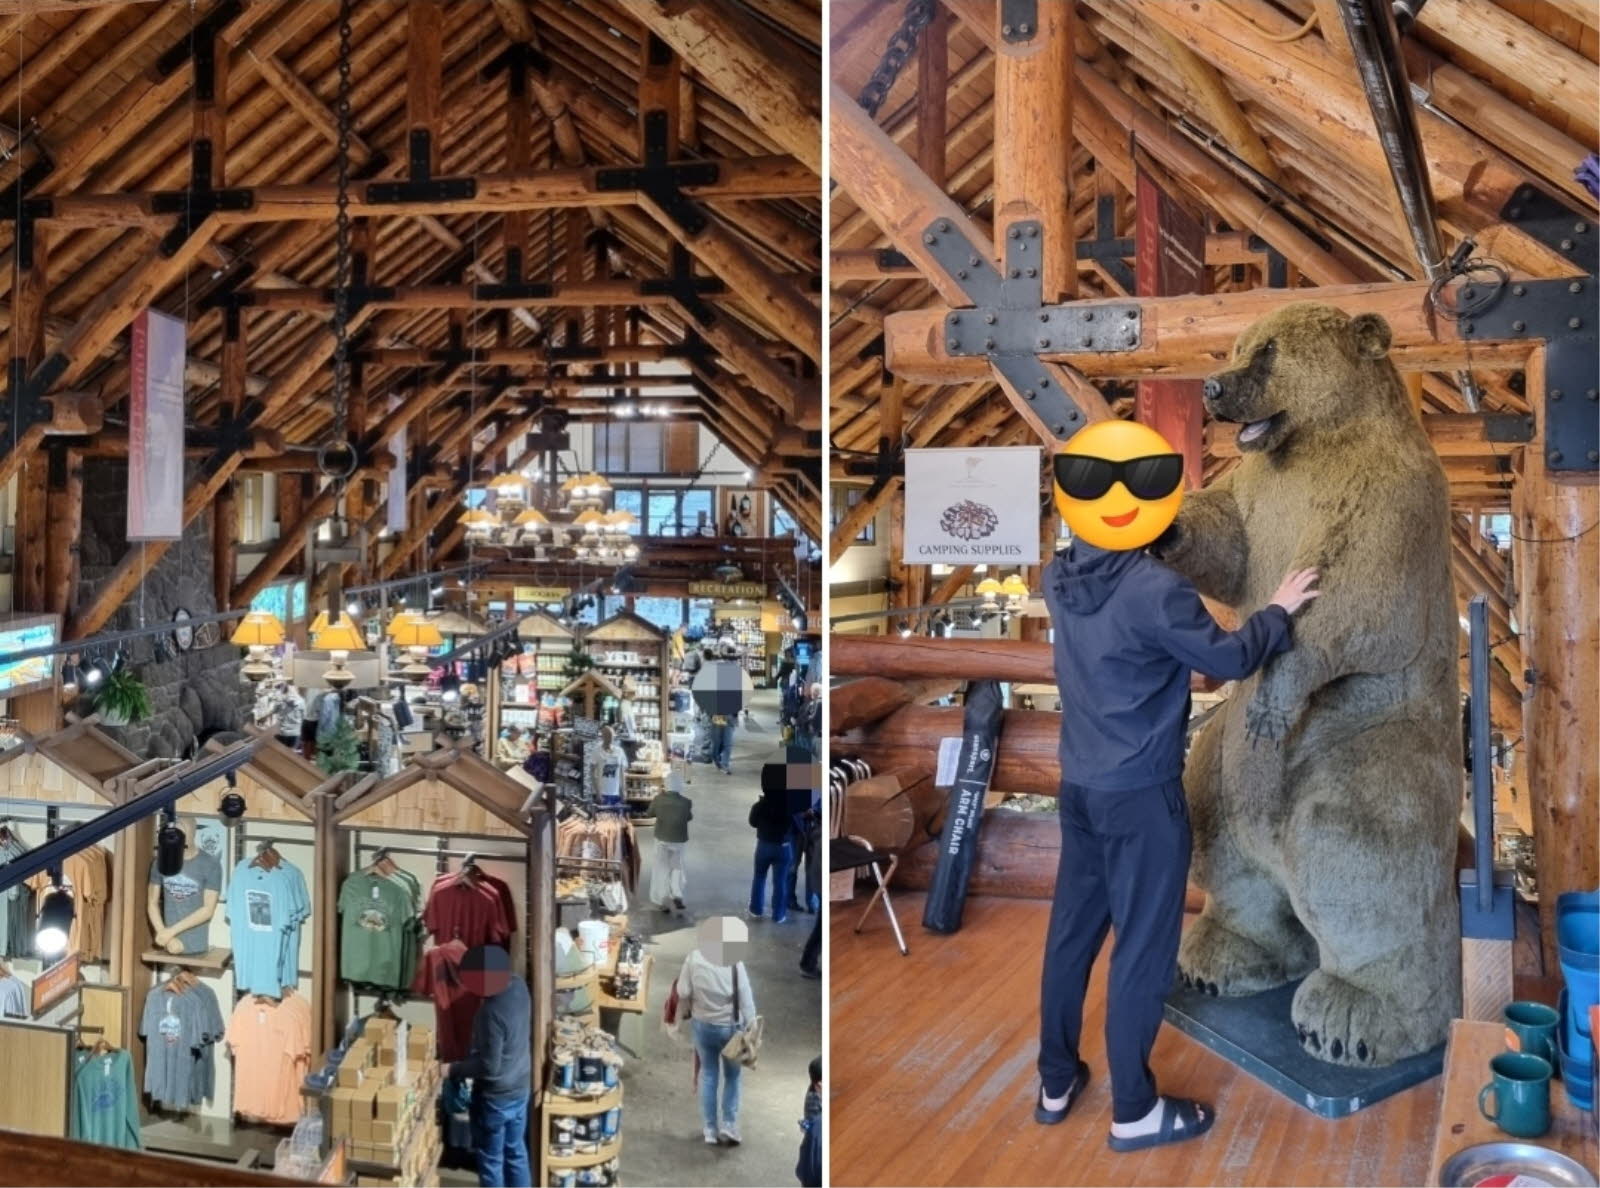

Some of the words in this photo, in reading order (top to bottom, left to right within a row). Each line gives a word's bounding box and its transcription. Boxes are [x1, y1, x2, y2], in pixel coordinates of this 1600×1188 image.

[919, 544, 968, 555] CAMPING
[970, 544, 1022, 556] SUPPLIES
[693, 583, 764, 595] RECREATION
[957, 789, 972, 815] ARM
[948, 818, 965, 855] CHAIR
